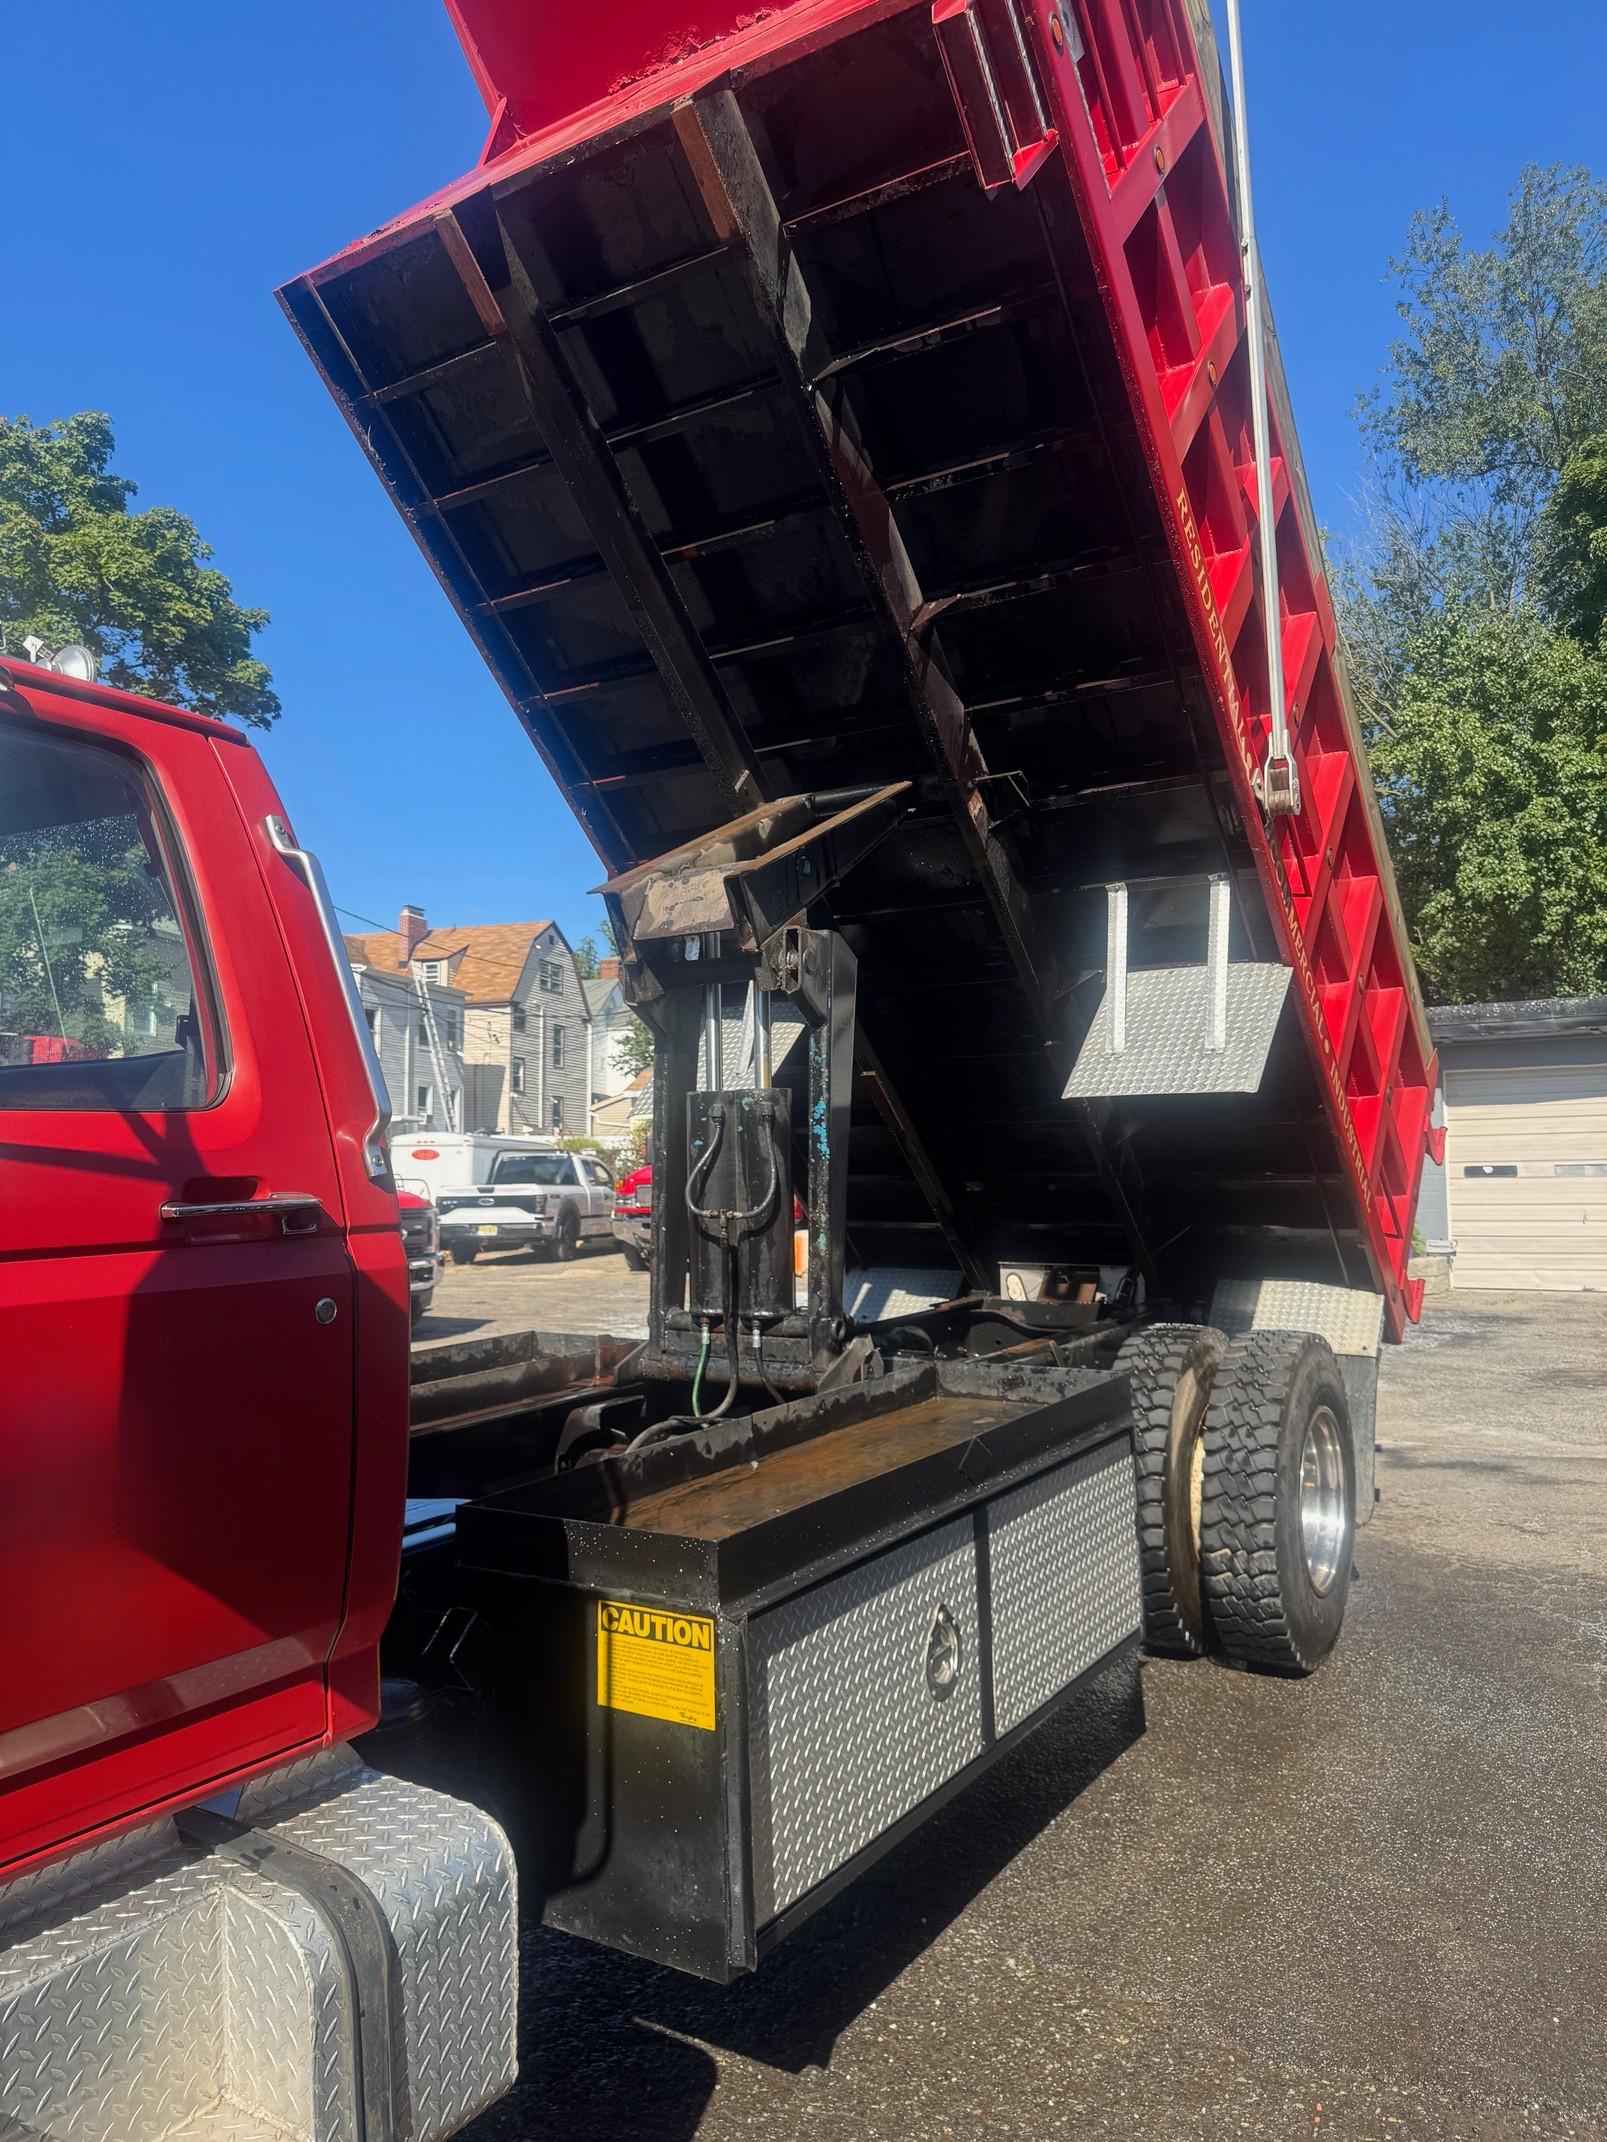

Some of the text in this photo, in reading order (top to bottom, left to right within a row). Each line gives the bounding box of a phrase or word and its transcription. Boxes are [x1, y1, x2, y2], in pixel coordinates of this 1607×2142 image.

[1176, 487, 1371, 1213] RESIDENTIAL COMMERCIAL INDUSTRIAL
[602, 1606, 710, 1650] CAUTION
